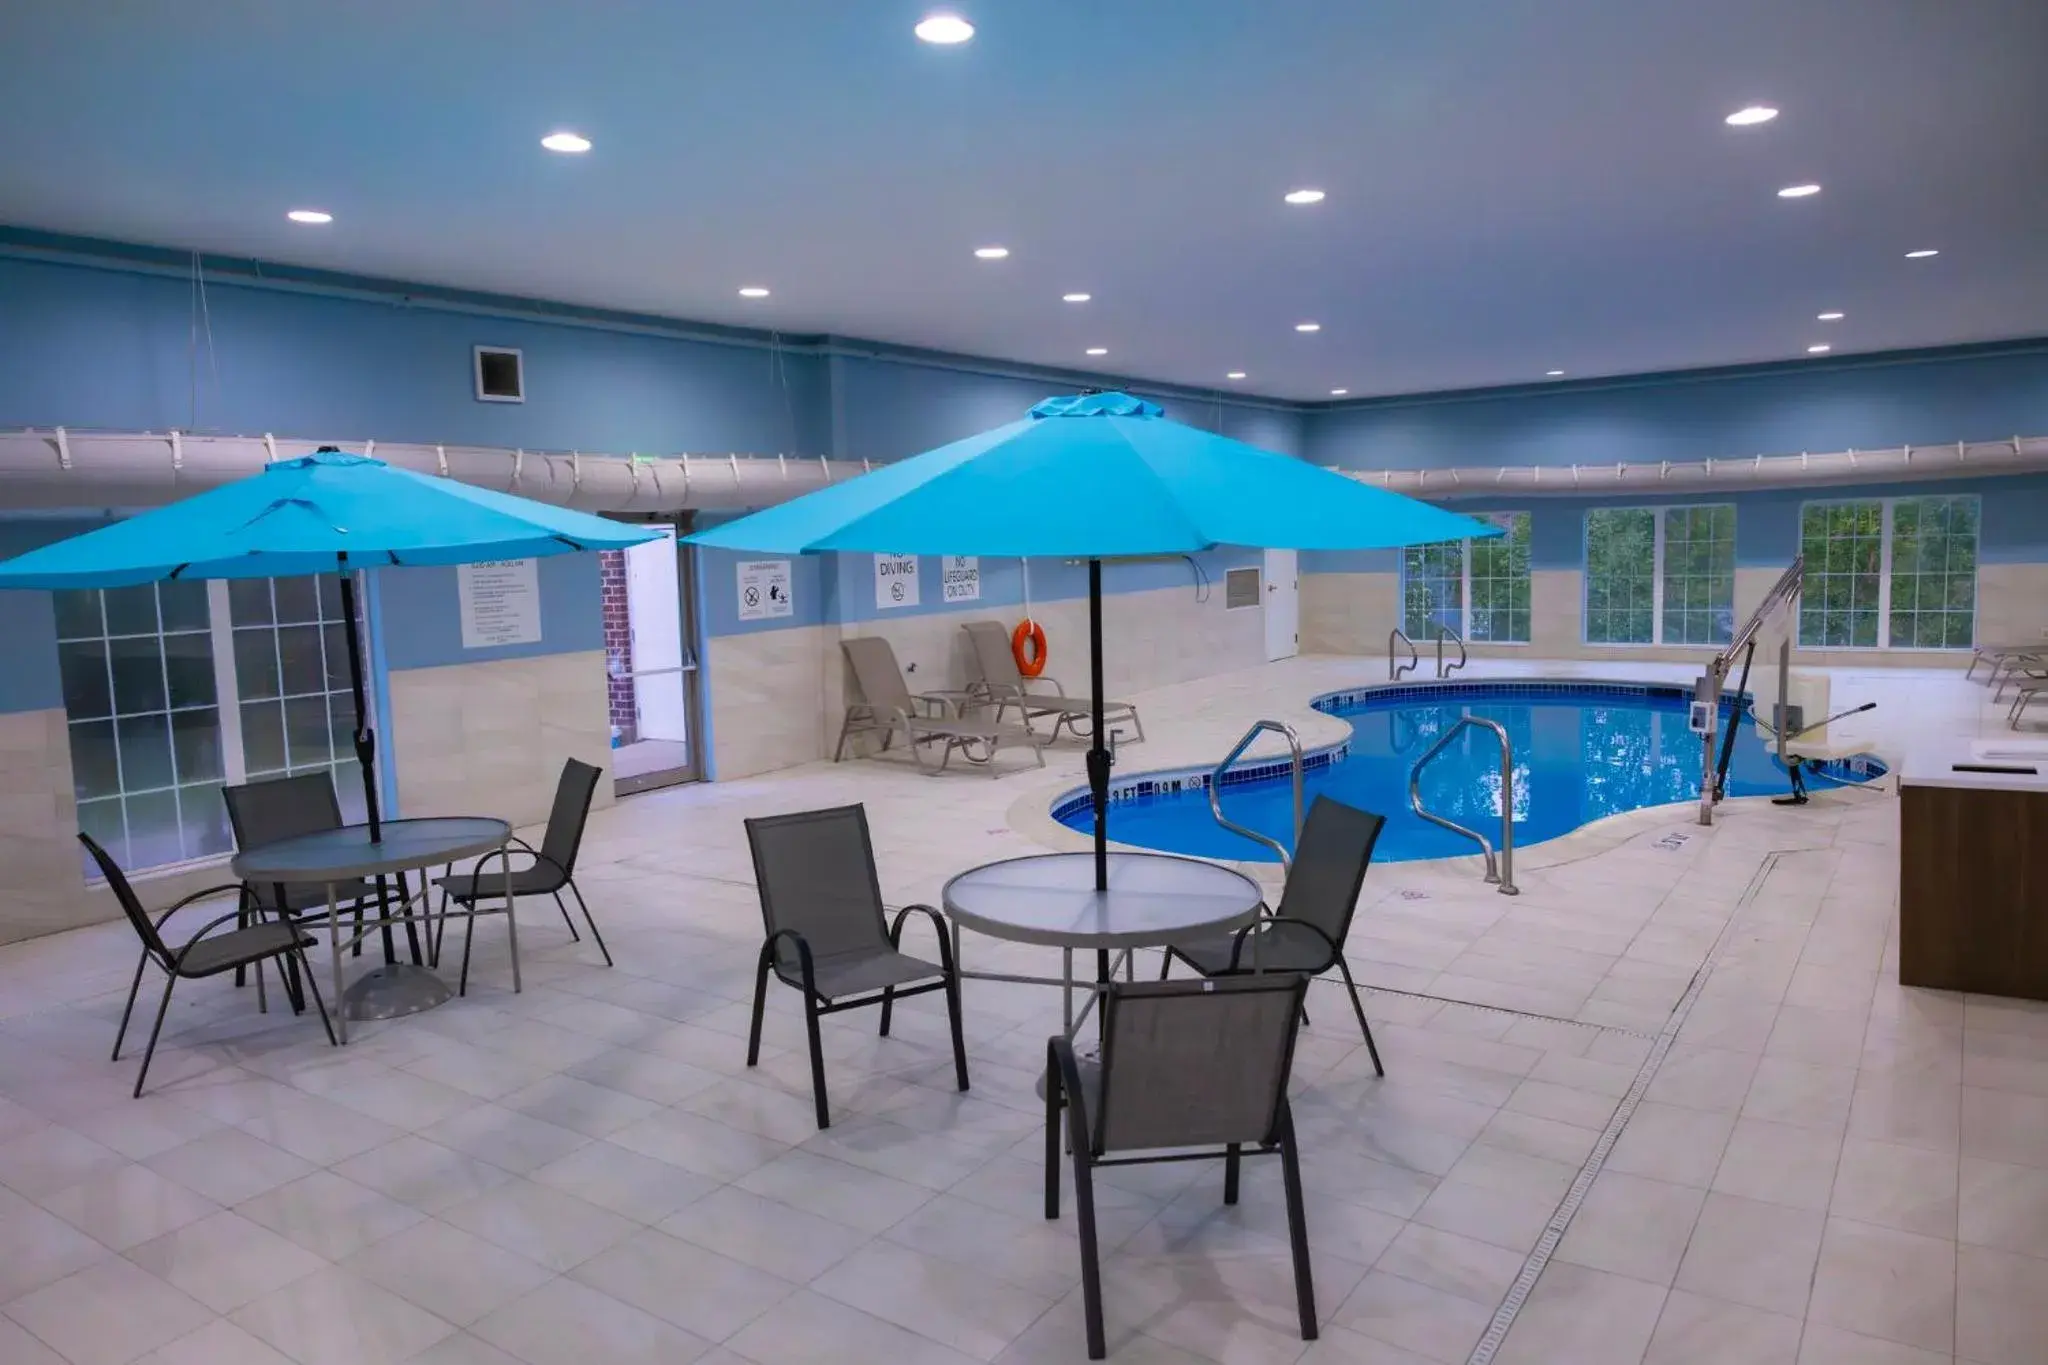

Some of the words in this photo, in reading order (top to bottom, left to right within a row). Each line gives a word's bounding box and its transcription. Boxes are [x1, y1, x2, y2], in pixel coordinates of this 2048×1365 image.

[880, 561, 914, 576] DIVING
[944, 569, 977, 583] LIFEGUARD
[947, 585, 957, 598] ON
[1123, 787, 1137, 800] FT
